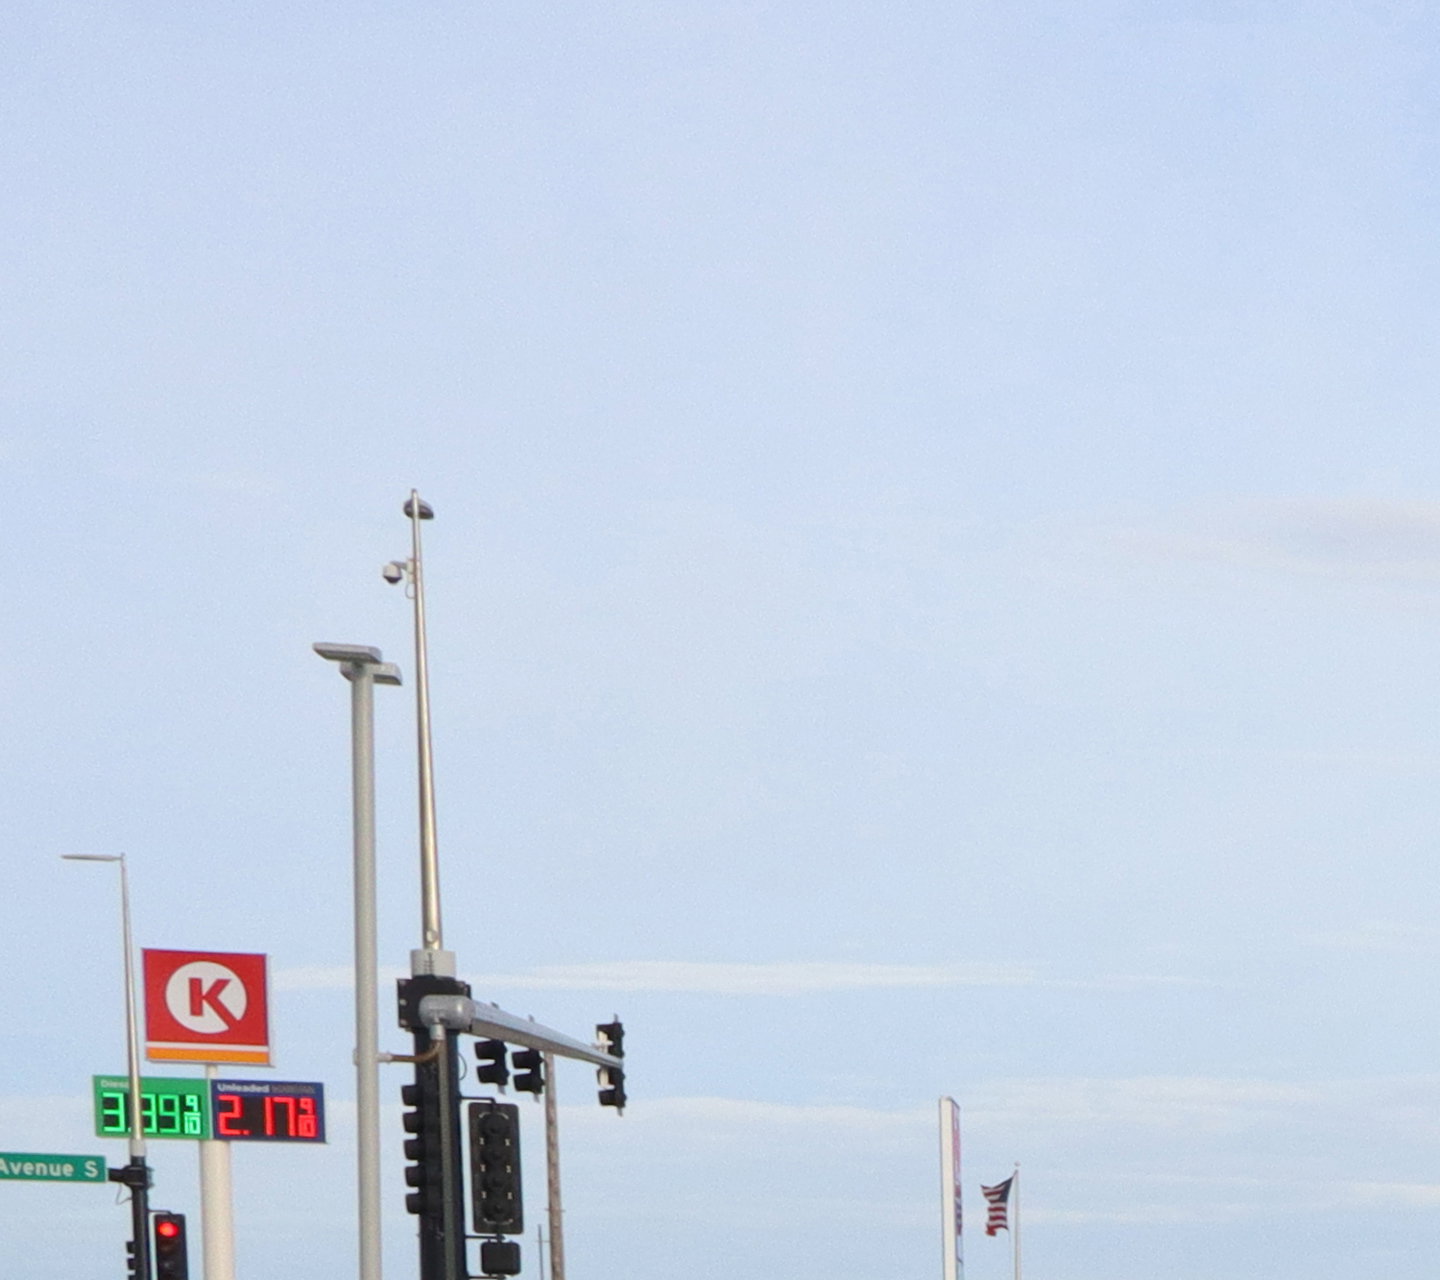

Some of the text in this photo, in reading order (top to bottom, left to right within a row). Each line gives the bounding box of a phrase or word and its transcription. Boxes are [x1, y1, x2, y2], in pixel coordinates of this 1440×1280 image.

[188, 976, 230, 1017] K
[217, 1083, 270, 1094] Unleaded
[217, 1094, 296, 1137] 2.17
[84, 1160, 99, 1178] S
